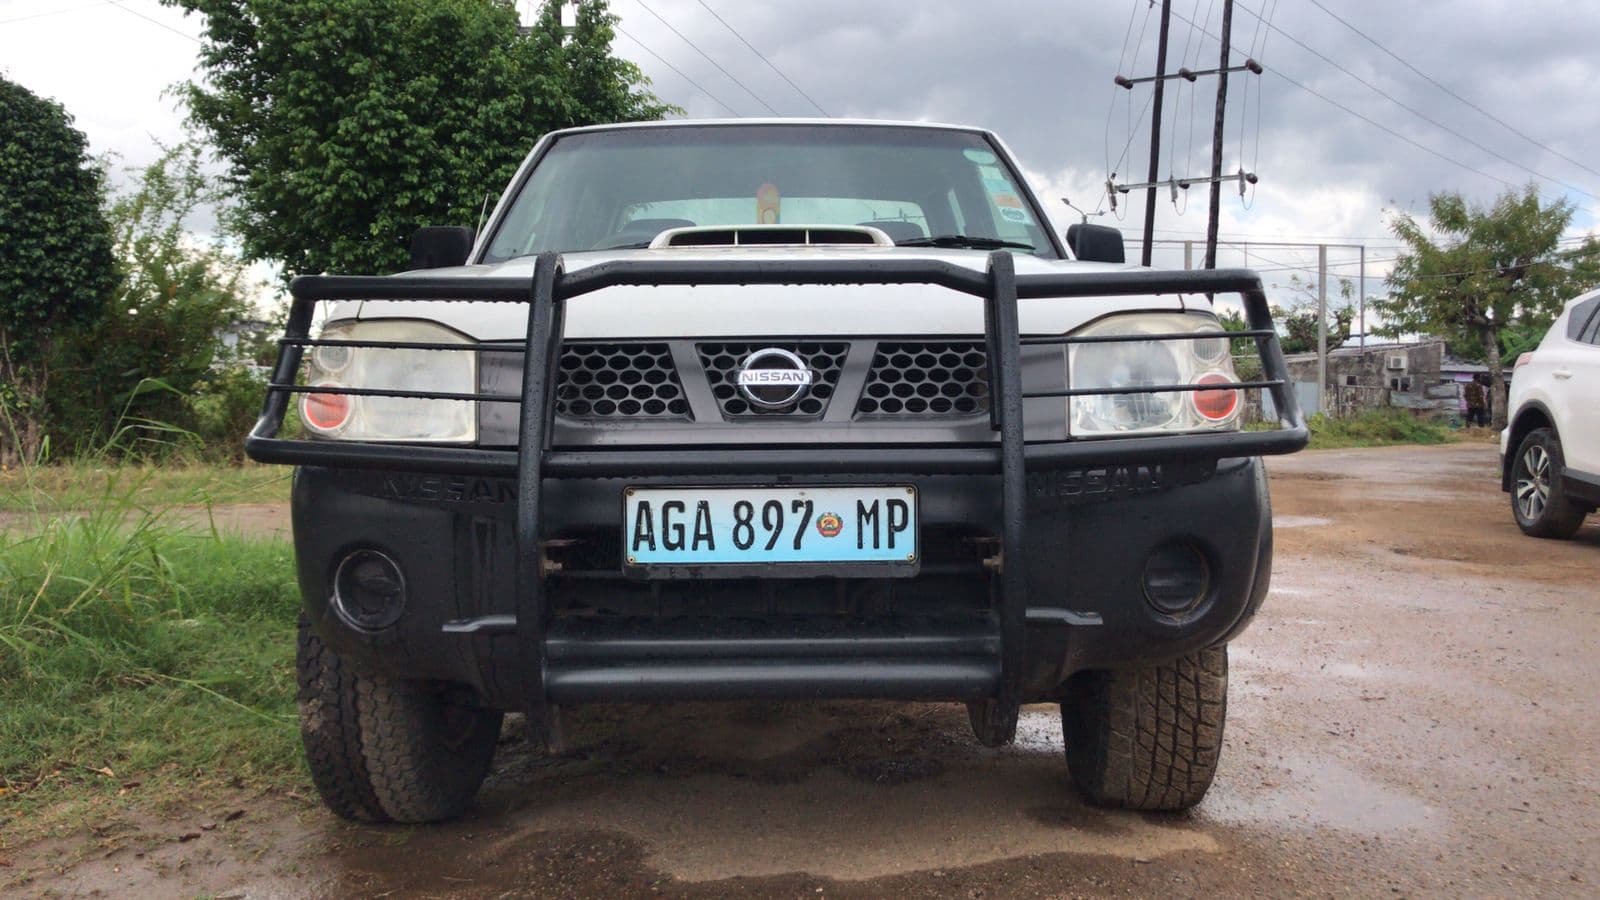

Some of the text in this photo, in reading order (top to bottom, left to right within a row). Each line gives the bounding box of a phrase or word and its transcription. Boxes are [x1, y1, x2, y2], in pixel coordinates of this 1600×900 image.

[742, 372, 804, 382] NISSAN
[632, 498, 909, 551] AGA 897 MP
